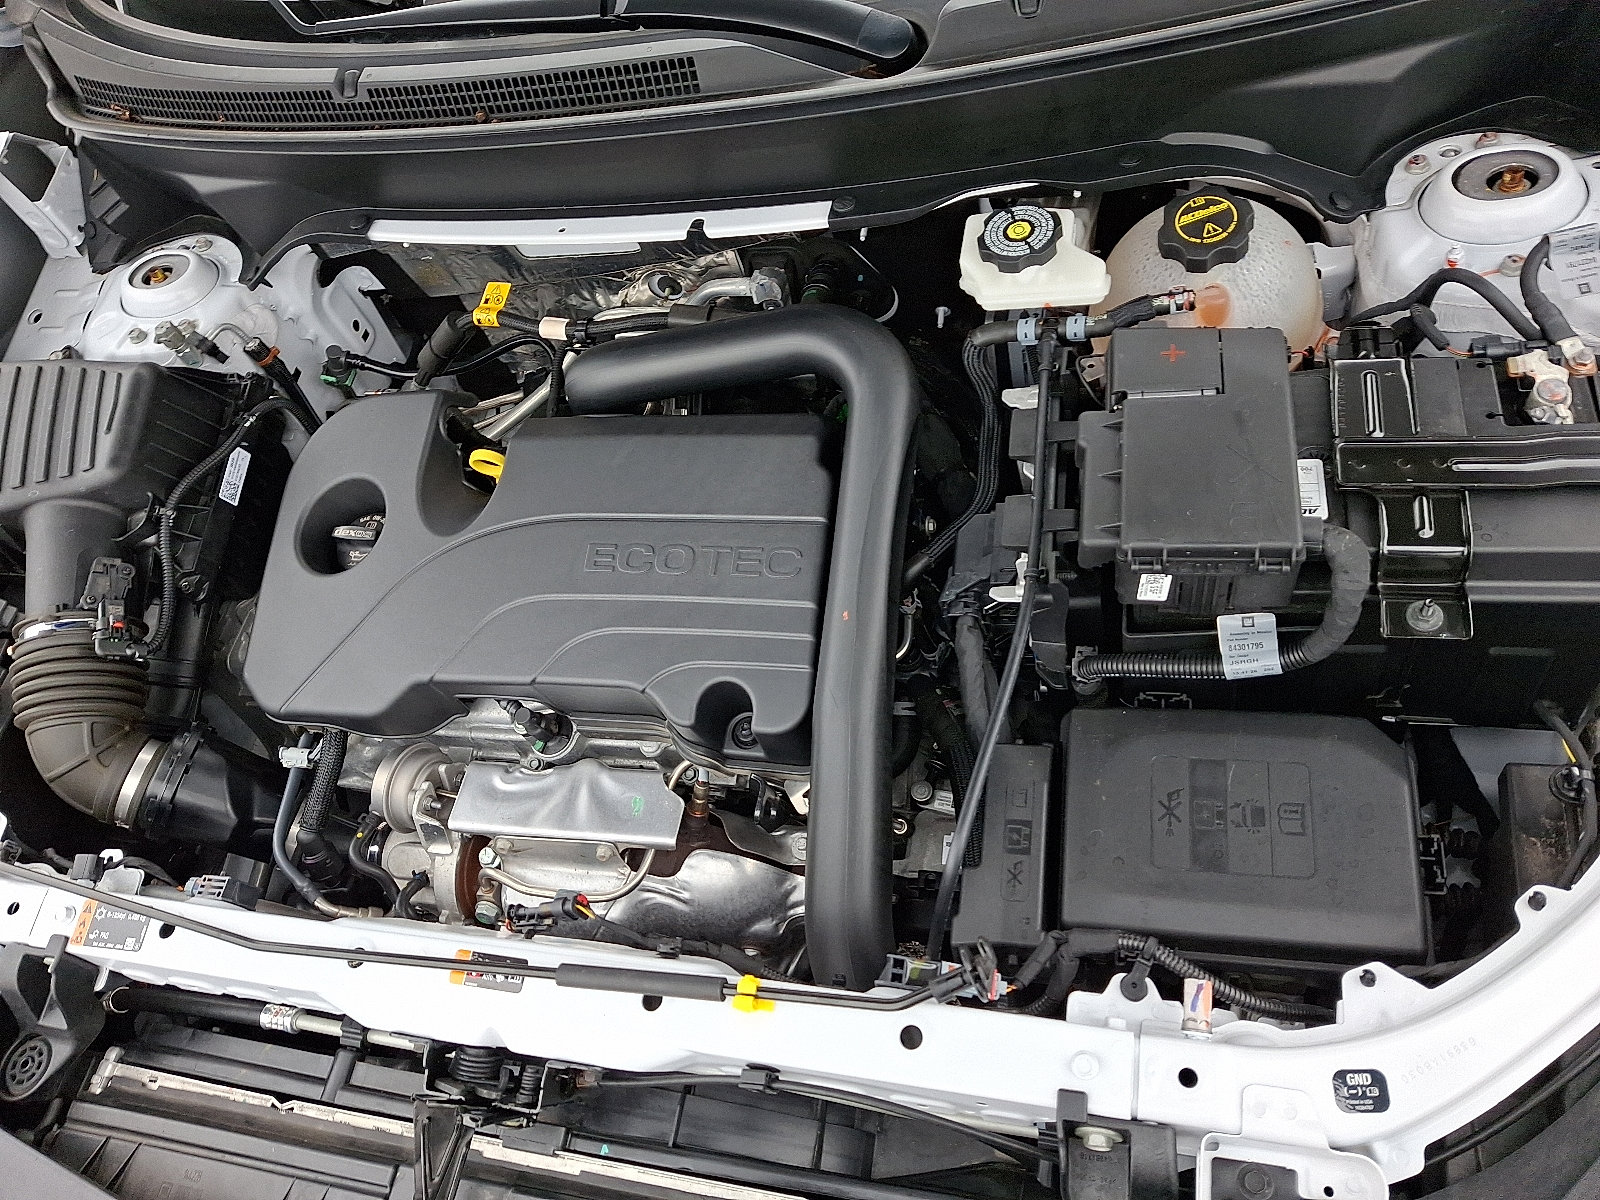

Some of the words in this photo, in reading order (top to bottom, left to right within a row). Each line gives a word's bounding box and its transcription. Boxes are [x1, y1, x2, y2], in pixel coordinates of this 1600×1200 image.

[584, 543, 803, 578] ECOTEC
[1228, 641, 1264, 652] 84301795
[1345, 1072, 1373, 1086] GND
